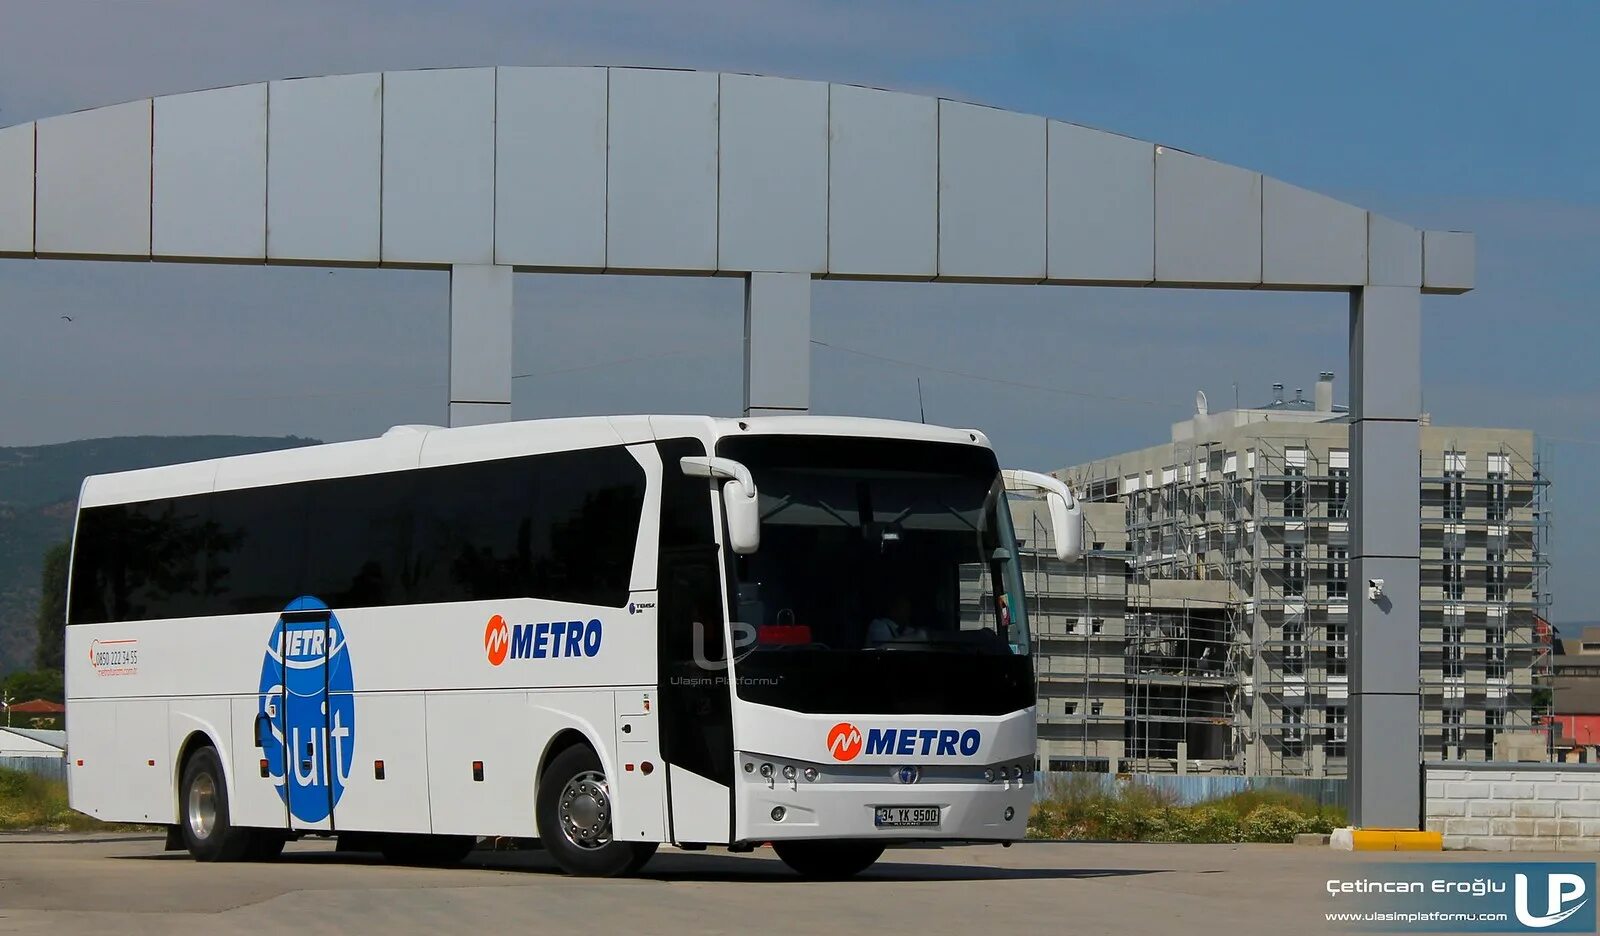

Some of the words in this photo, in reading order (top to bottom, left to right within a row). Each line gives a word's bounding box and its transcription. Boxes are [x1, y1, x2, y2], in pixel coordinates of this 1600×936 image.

[510, 618, 603, 660] METRO
[96, 652, 110, 665] 0850
[111, 651, 121, 665] 222
[264, 685, 350, 787] Suit
[865, 728, 981, 757] METRO
[882, 809, 894, 821] 34
[899, 809, 910, 821] YK
[913, 809, 937, 821] 9500
